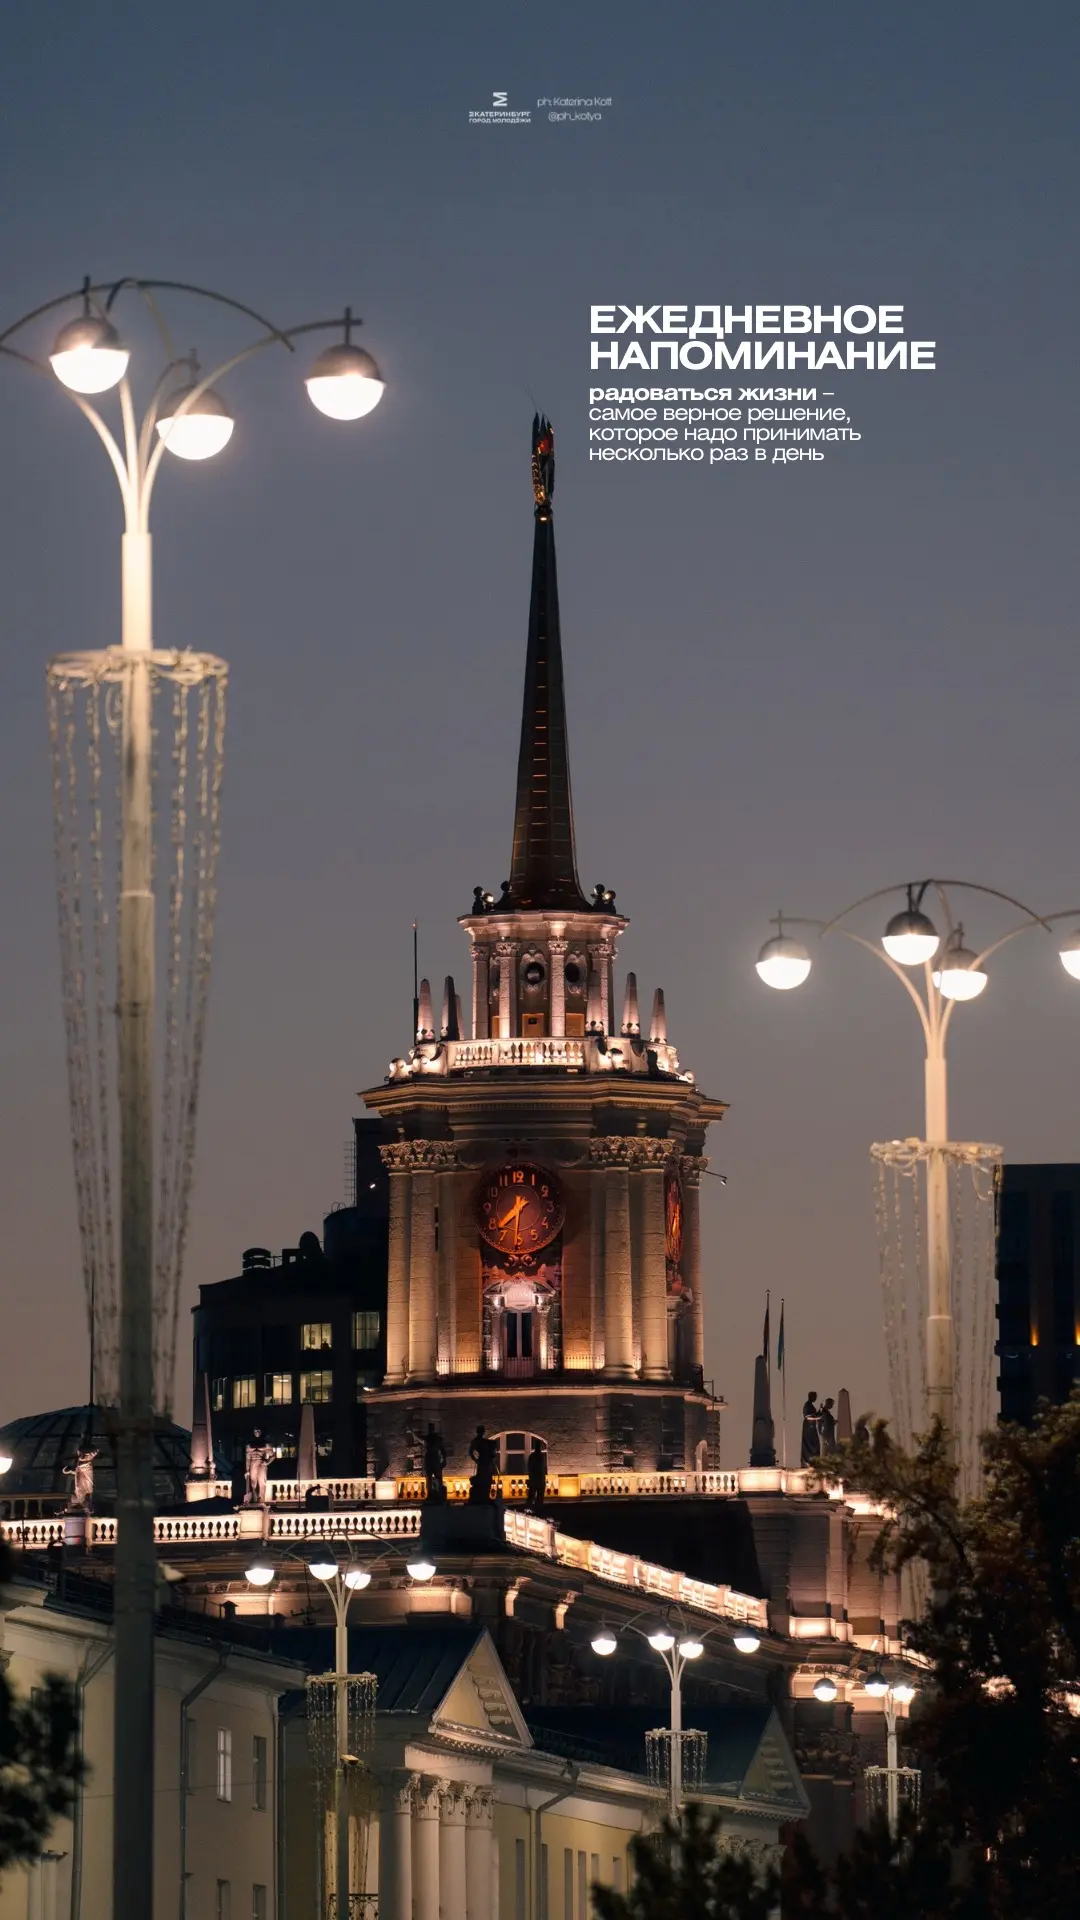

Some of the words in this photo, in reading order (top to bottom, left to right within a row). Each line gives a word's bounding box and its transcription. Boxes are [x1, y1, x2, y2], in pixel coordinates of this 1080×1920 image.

[513, 1171, 524, 1183] 12
[483, 1203, 491, 1215] 9
[546, 1201, 554, 1212] 3
[488, 1217, 497, 1230] 8
[541, 1217, 549, 1228] 4
[499, 1230, 508, 1241] 7
[530, 1229, 539, 1241] 5
